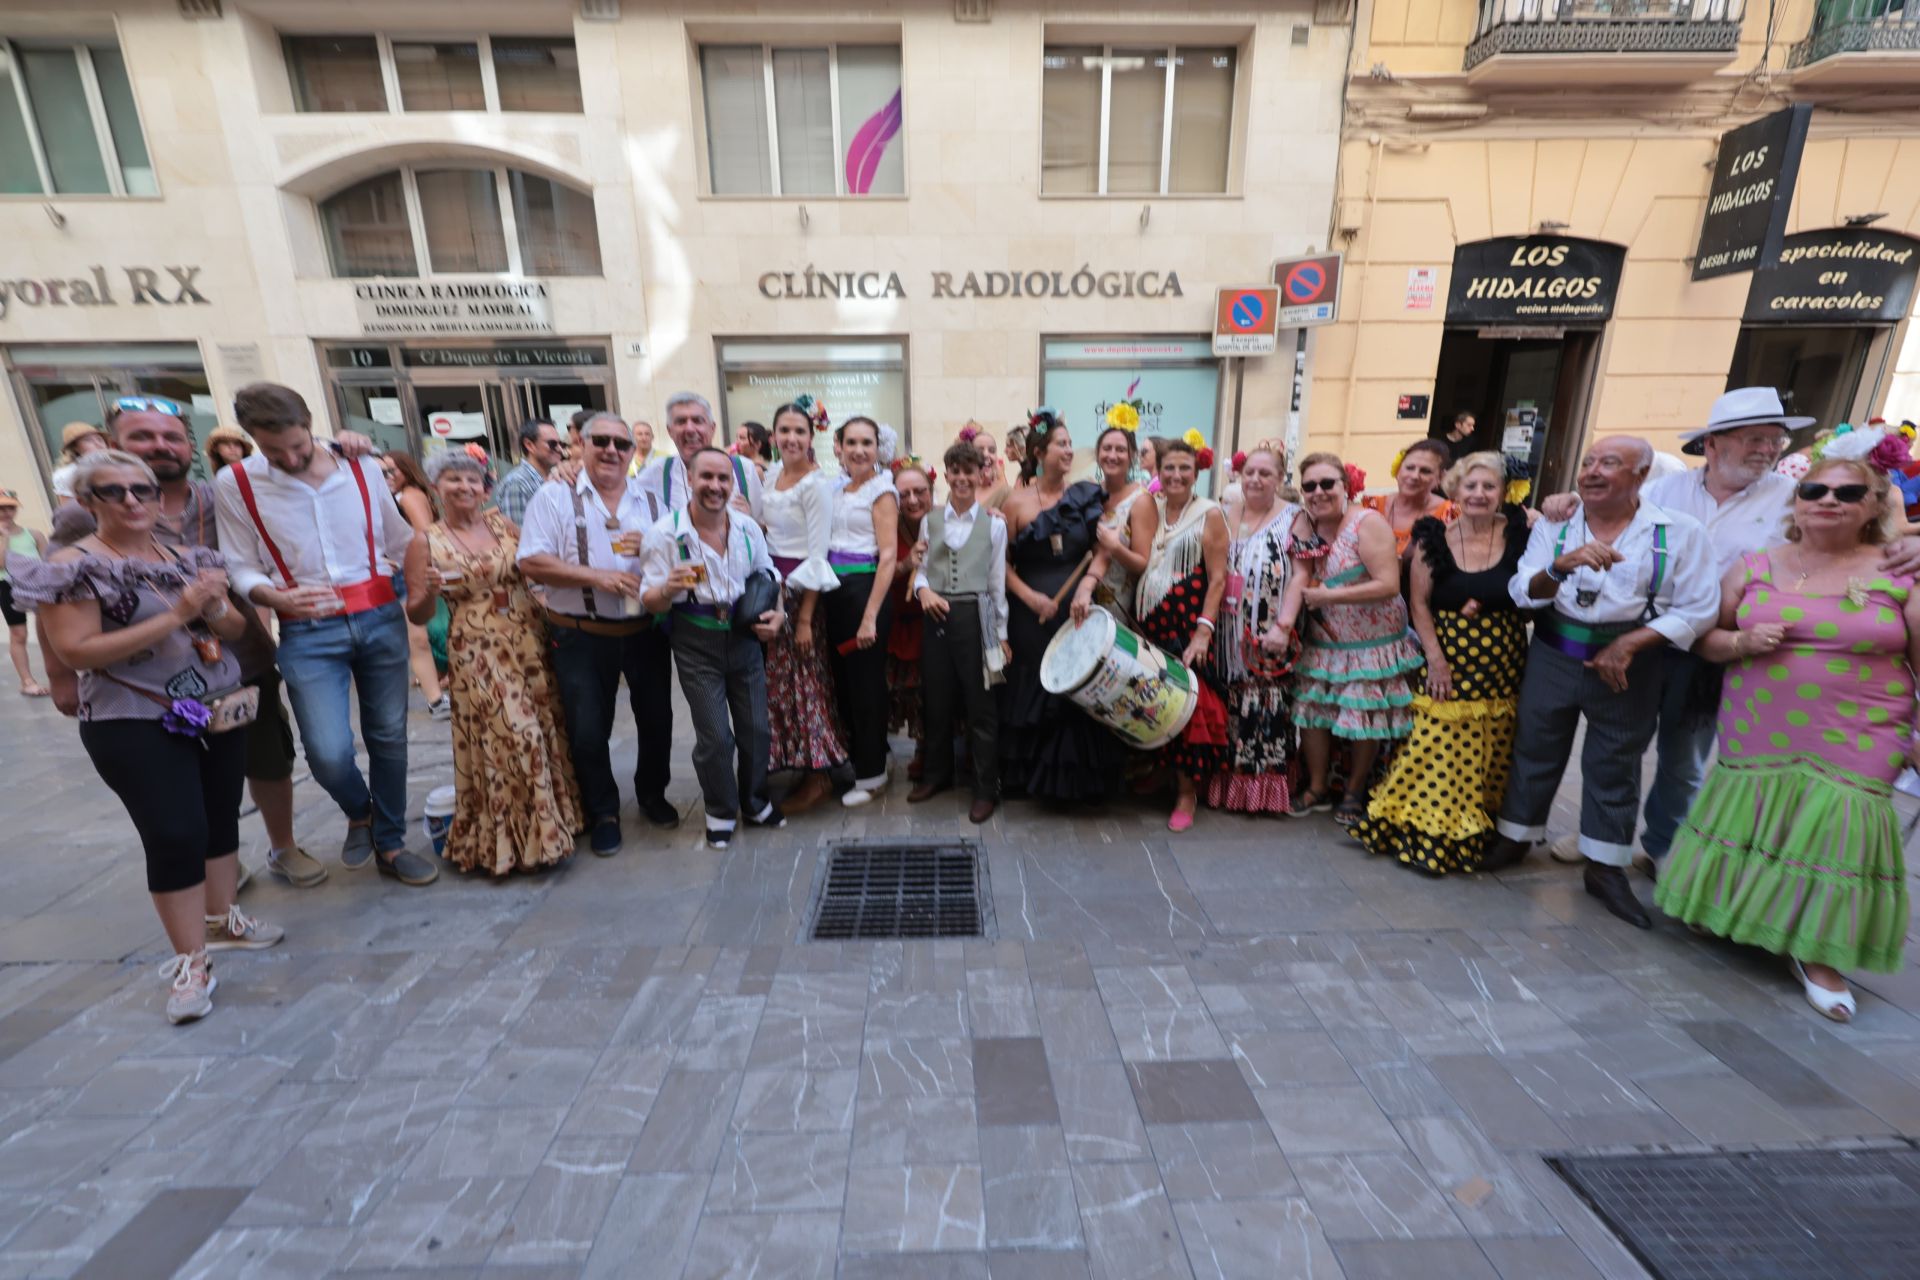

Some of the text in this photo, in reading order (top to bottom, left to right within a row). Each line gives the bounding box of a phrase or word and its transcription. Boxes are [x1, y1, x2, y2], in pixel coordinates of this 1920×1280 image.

[1730, 145, 1769, 176] LOS
[1710, 178, 1774, 216] HIDALGOS
[1510, 245, 1570, 267] LOS
[1699, 245, 1758, 270] DESDE 1968
[122, 265, 212, 305] RX
[758, 264, 1183, 299] CLÍNICA RADIOLÓGICA
[1466, 276, 1602, 299] HIDALGOS
[1818, 271, 1848, 285] en
[355, 284, 426, 299] CLINICA
[1771, 292, 1883, 310] caracoles
[1516, 304, 1548, 314] cocina
[350, 350, 373, 367] 10
[440, 350, 490, 367] Duque
[494, 350, 513, 365] de
[516, 350, 531, 364] la
[533, 350, 592, 364] Victoria
[816, 373, 860, 386] Mayoral
